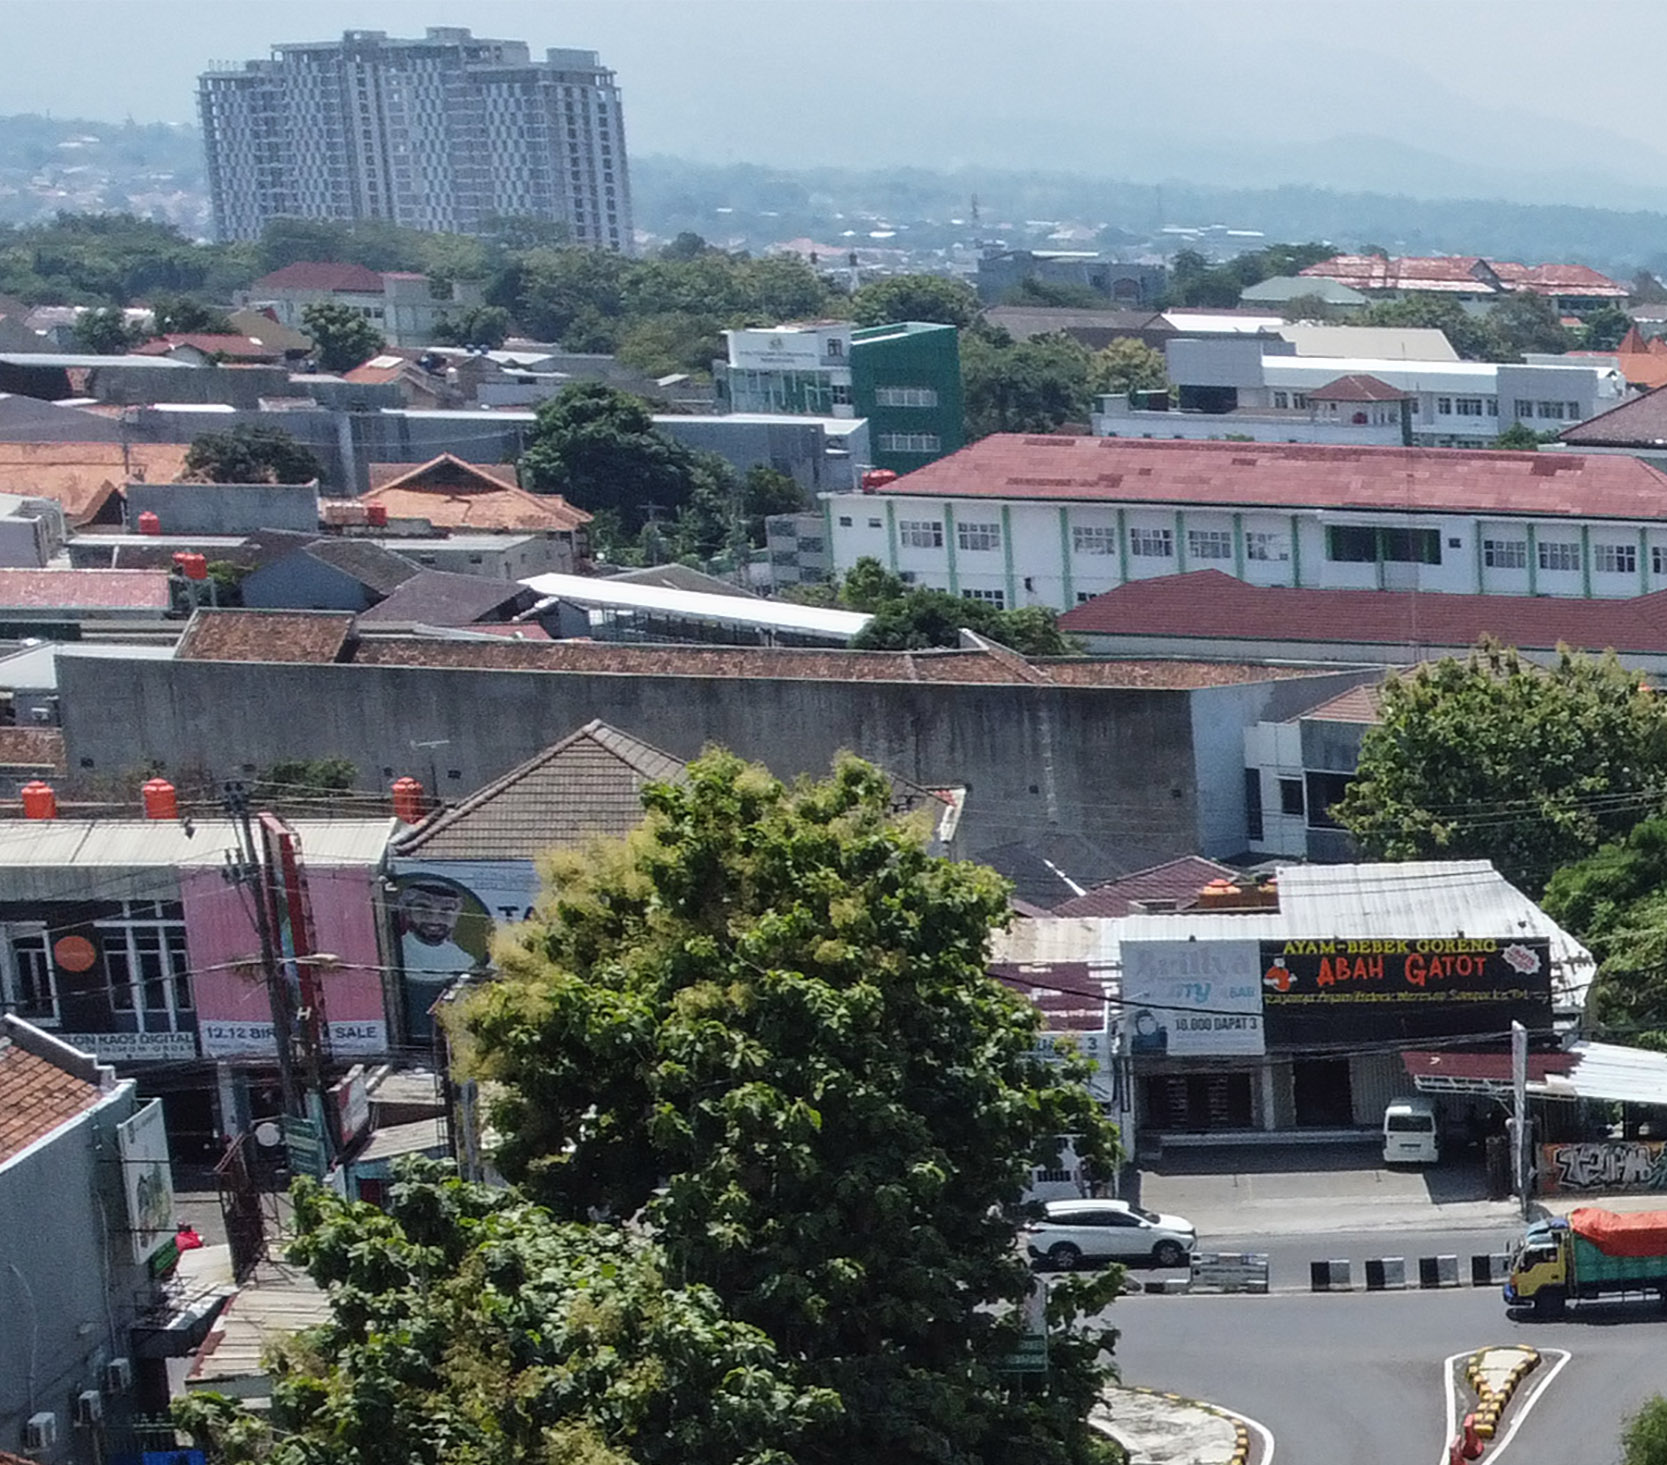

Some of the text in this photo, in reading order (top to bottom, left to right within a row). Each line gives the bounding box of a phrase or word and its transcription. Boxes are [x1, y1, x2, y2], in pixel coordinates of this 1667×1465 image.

[1283, 938, 1498, 955] AYAM-BEBEK GORENG
[1316, 955, 1384, 987] ABAH
[1404, 953, 1487, 986] GATOT
[1214, 1017, 1248, 1031] DAPAT
[99, 1034, 136, 1045] KAOS
[139, 1033, 194, 1045] DIGITAL
[335, 1026, 377, 1039] SALE
